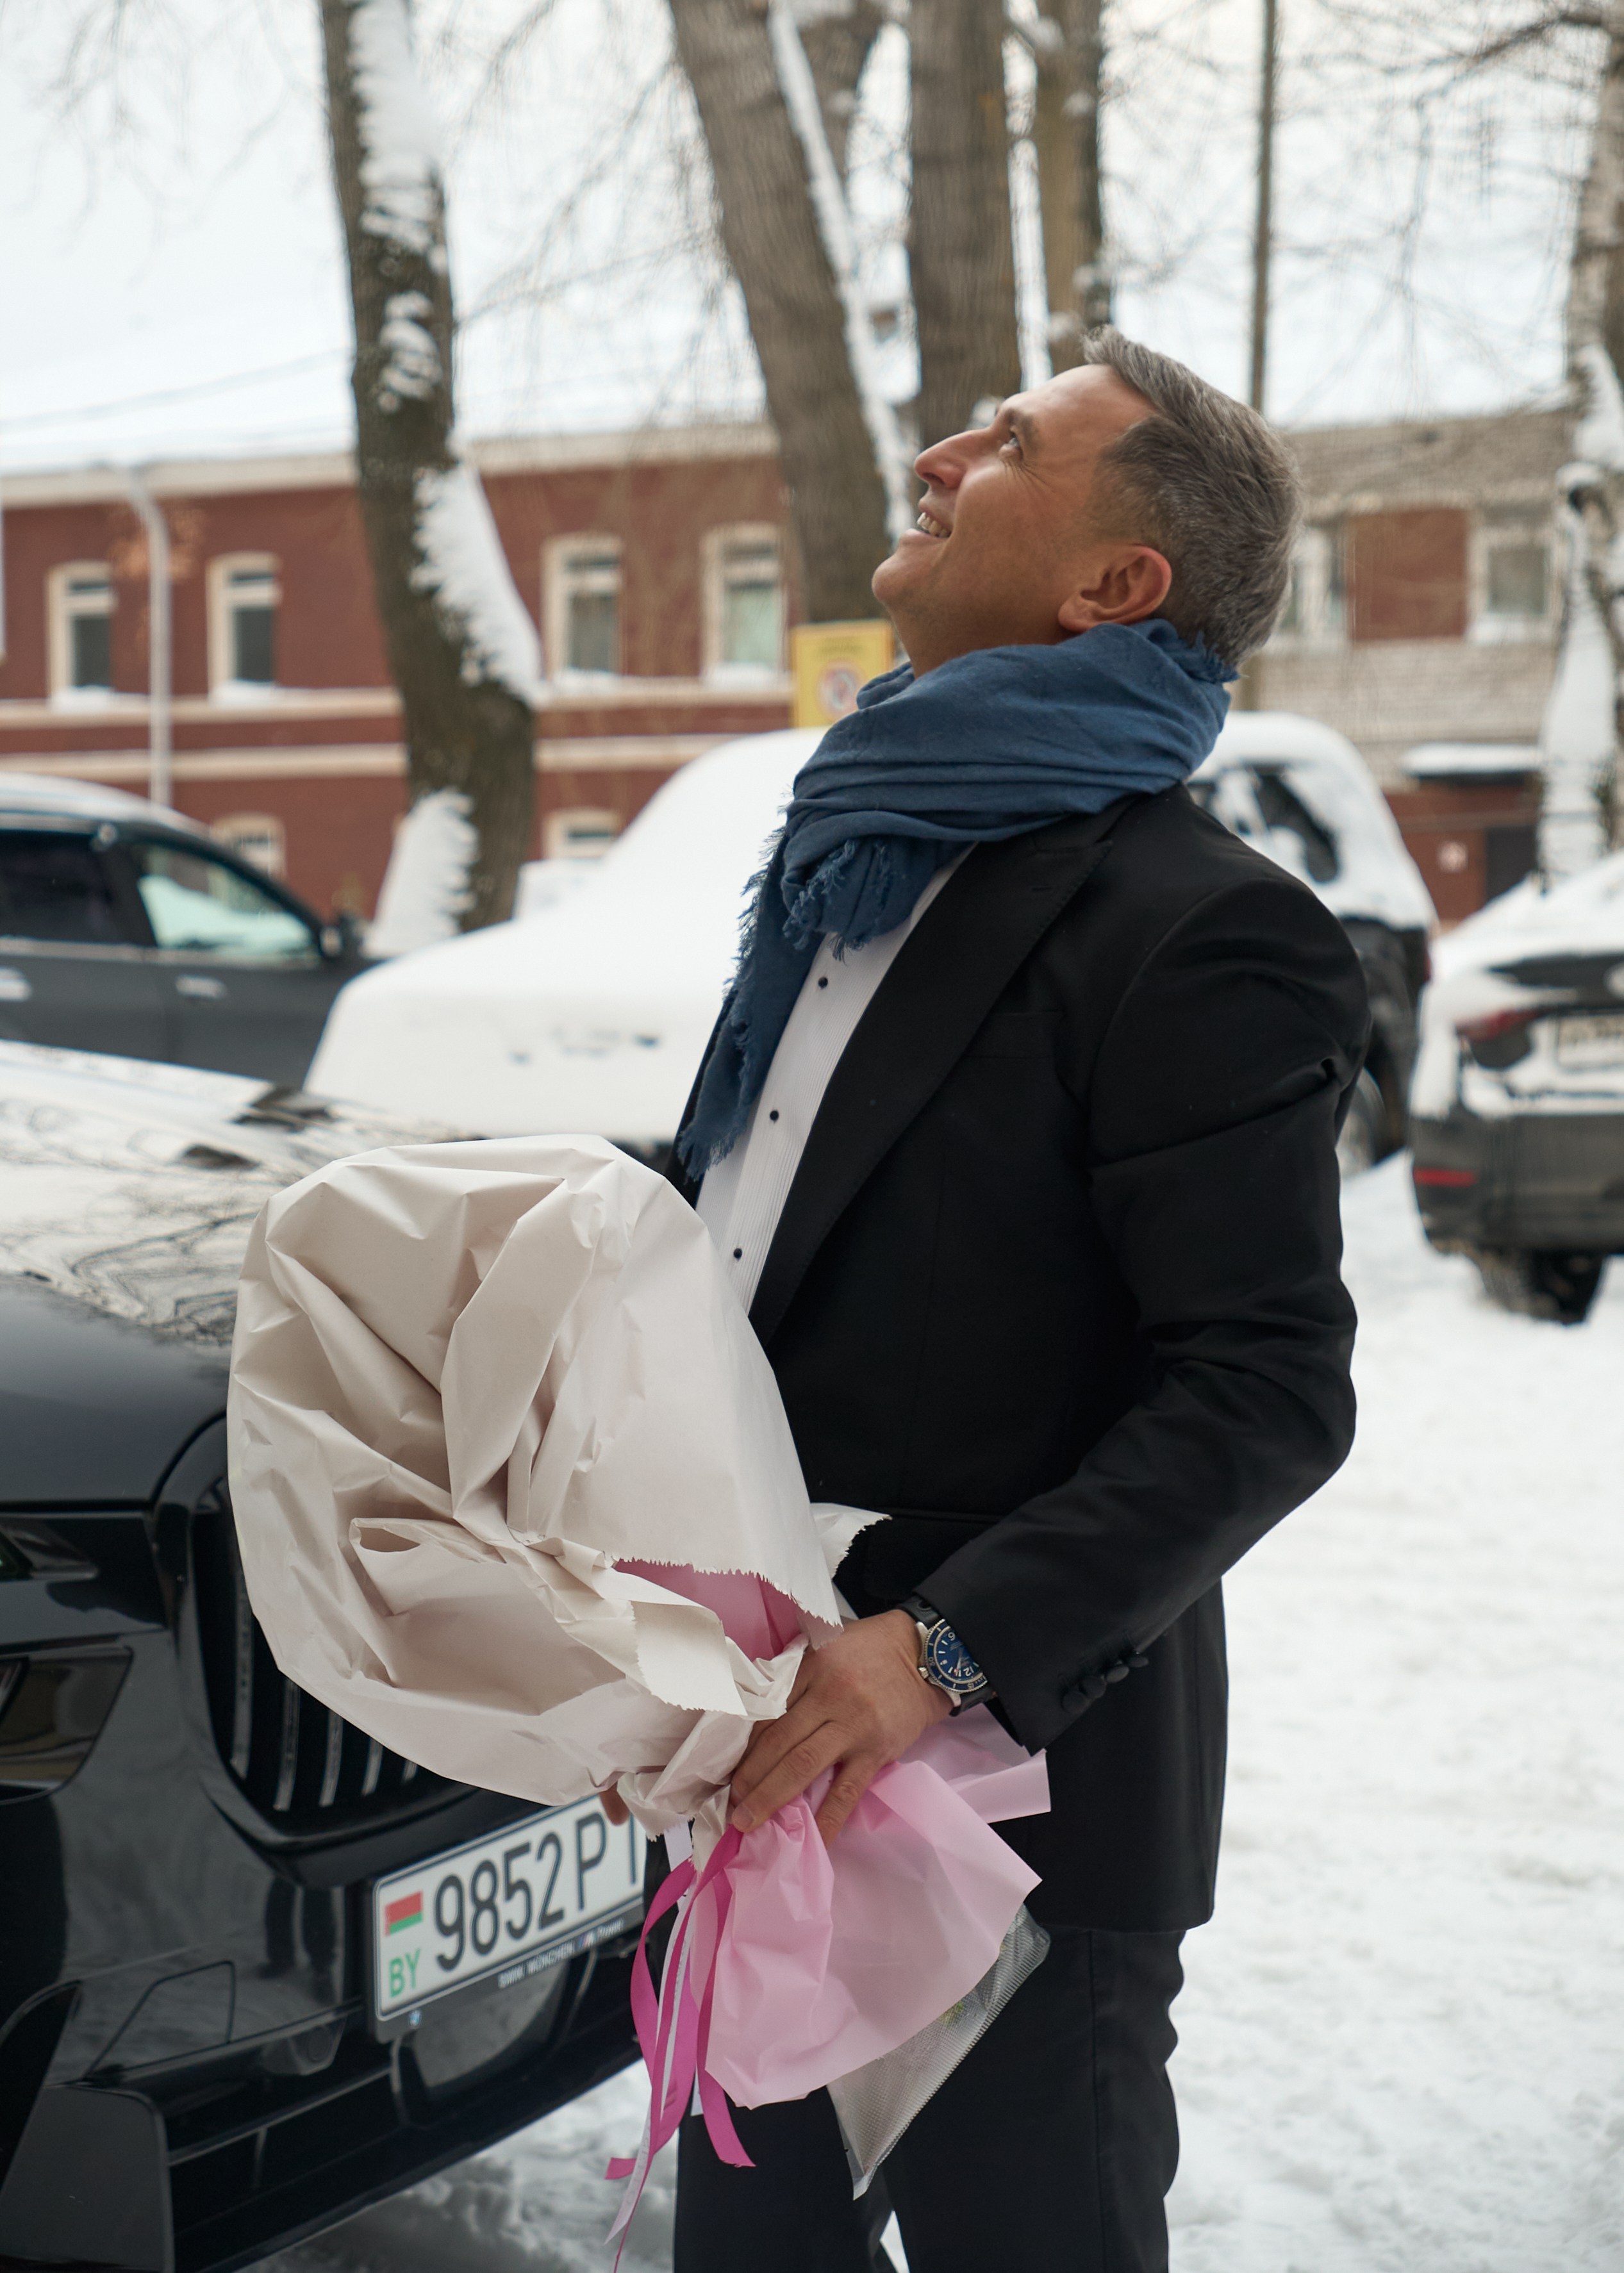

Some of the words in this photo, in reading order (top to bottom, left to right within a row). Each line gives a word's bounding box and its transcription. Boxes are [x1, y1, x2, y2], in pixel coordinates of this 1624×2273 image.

[948, 1632, 956, 1641] 6
[963, 1666, 974, 1676] 12
[434, 1831, 565, 1972] 9852
[389, 1948, 421, 1997] BY
